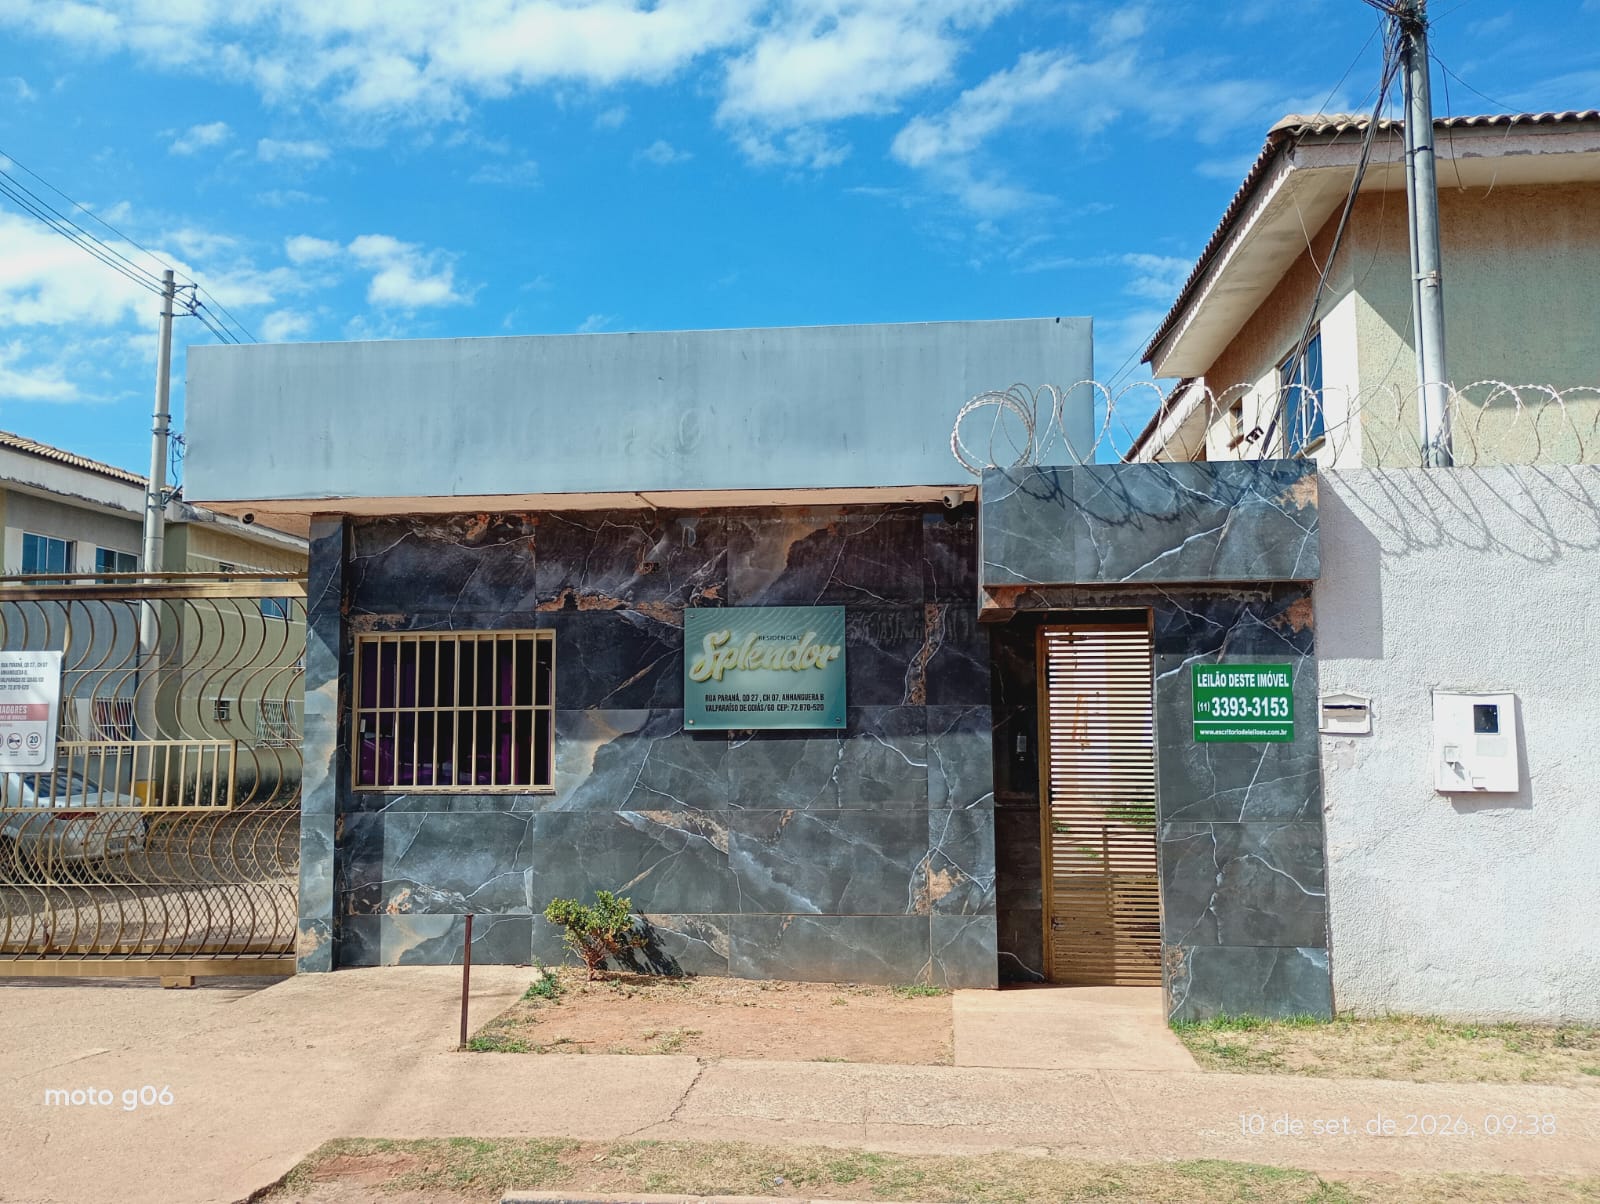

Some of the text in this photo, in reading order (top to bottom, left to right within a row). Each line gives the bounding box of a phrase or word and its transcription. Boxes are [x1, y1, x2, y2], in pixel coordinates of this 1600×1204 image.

[689, 630, 841, 682] Splendor
[1197, 671, 1290, 687] LEILÃO DESTE IMÓVEL
[705, 694, 716, 702] RUA
[763, 694, 770, 702] CH
[782, 693, 818, 701] ANHANGUERA
[705, 703, 738, 712] VALPARAÍSO
[748, 703, 774, 711] GOIÁS/GO
[777, 703, 789, 711] CEP:
[791, 703, 825, 711] 72.870-520
[1197, 697, 1289, 717] (11) 3393-3153
